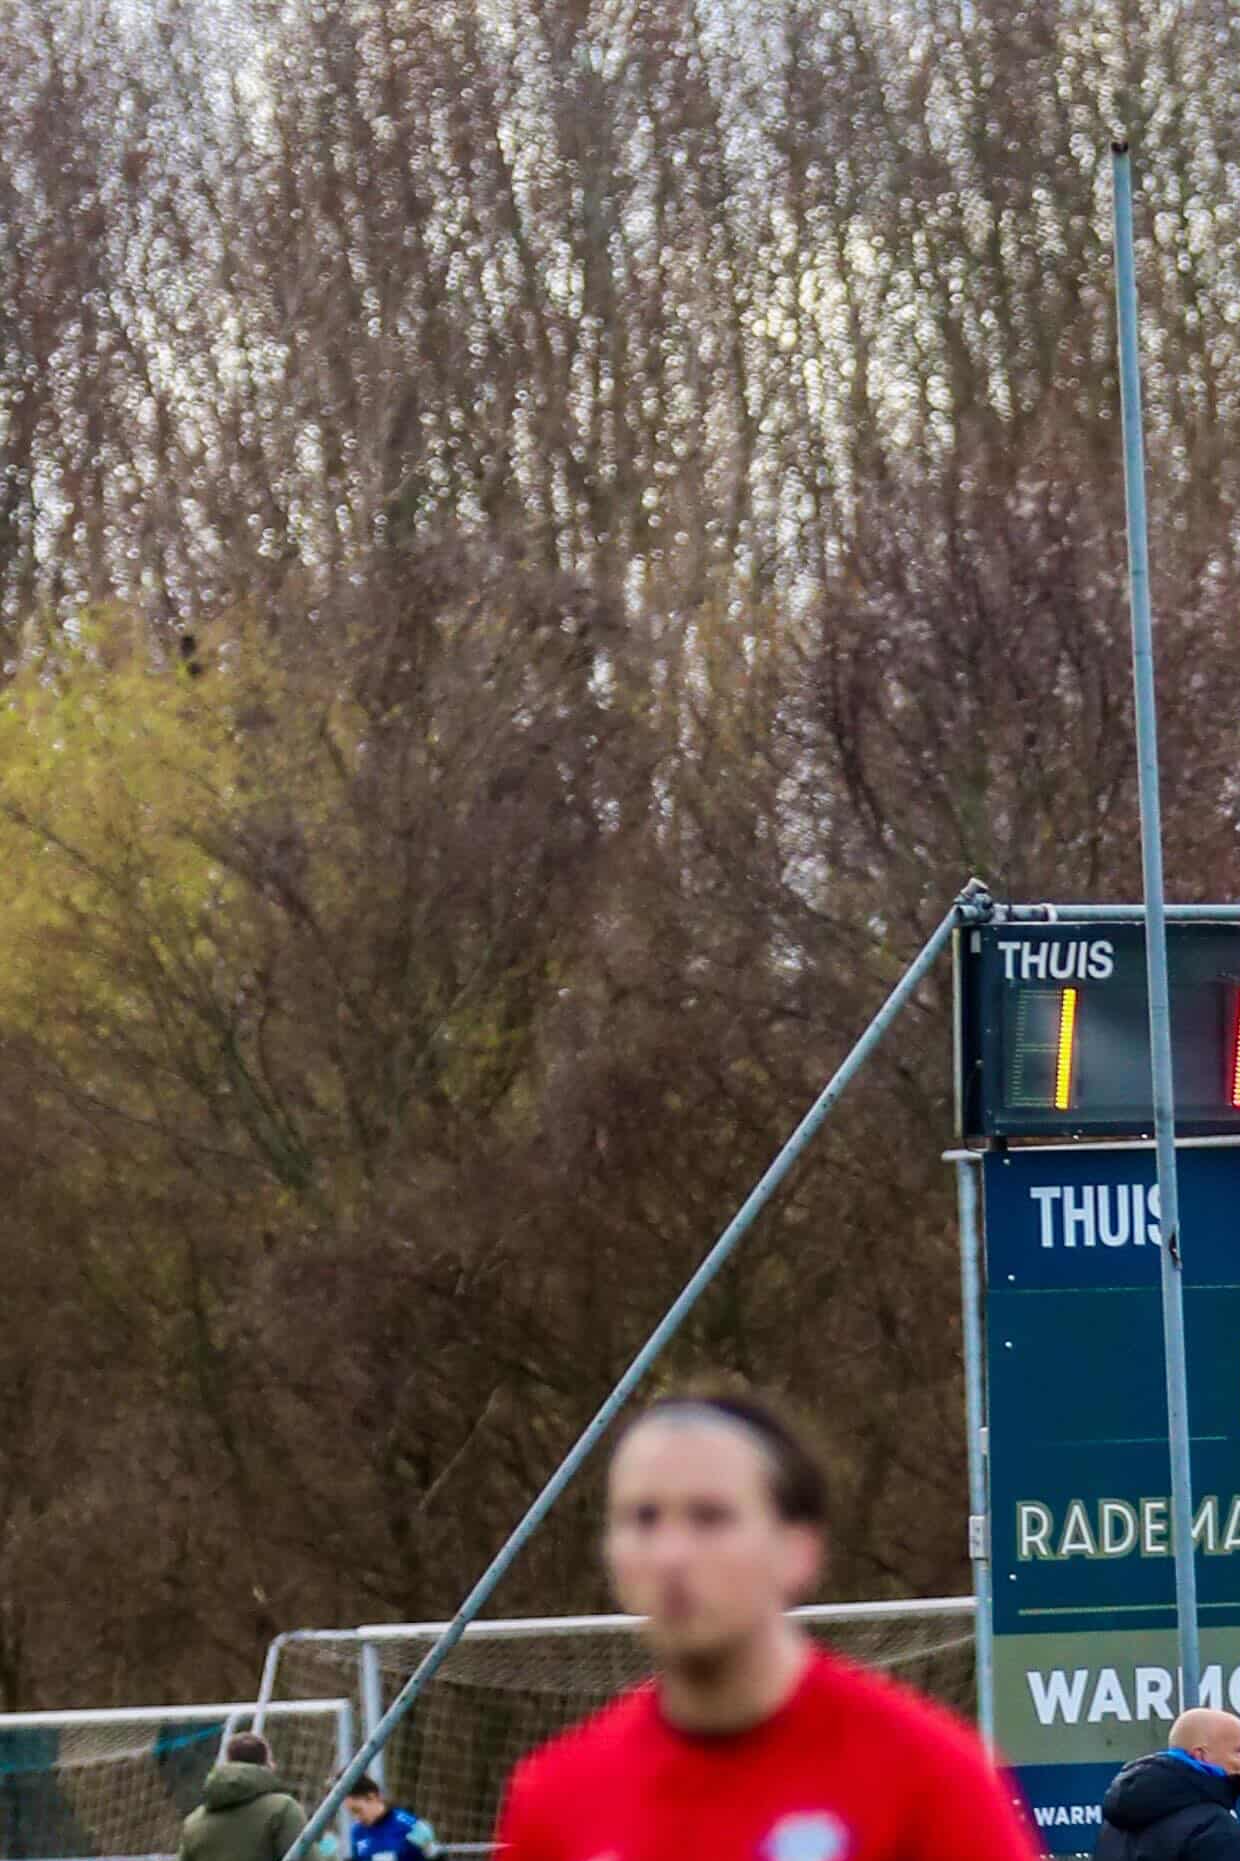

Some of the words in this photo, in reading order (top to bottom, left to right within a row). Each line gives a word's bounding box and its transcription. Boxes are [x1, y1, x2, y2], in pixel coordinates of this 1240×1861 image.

[997, 940, 1114, 979] THUIS
[1054, 987, 1078, 1110] 1
[1033, 1805, 1102, 1827] WARM
